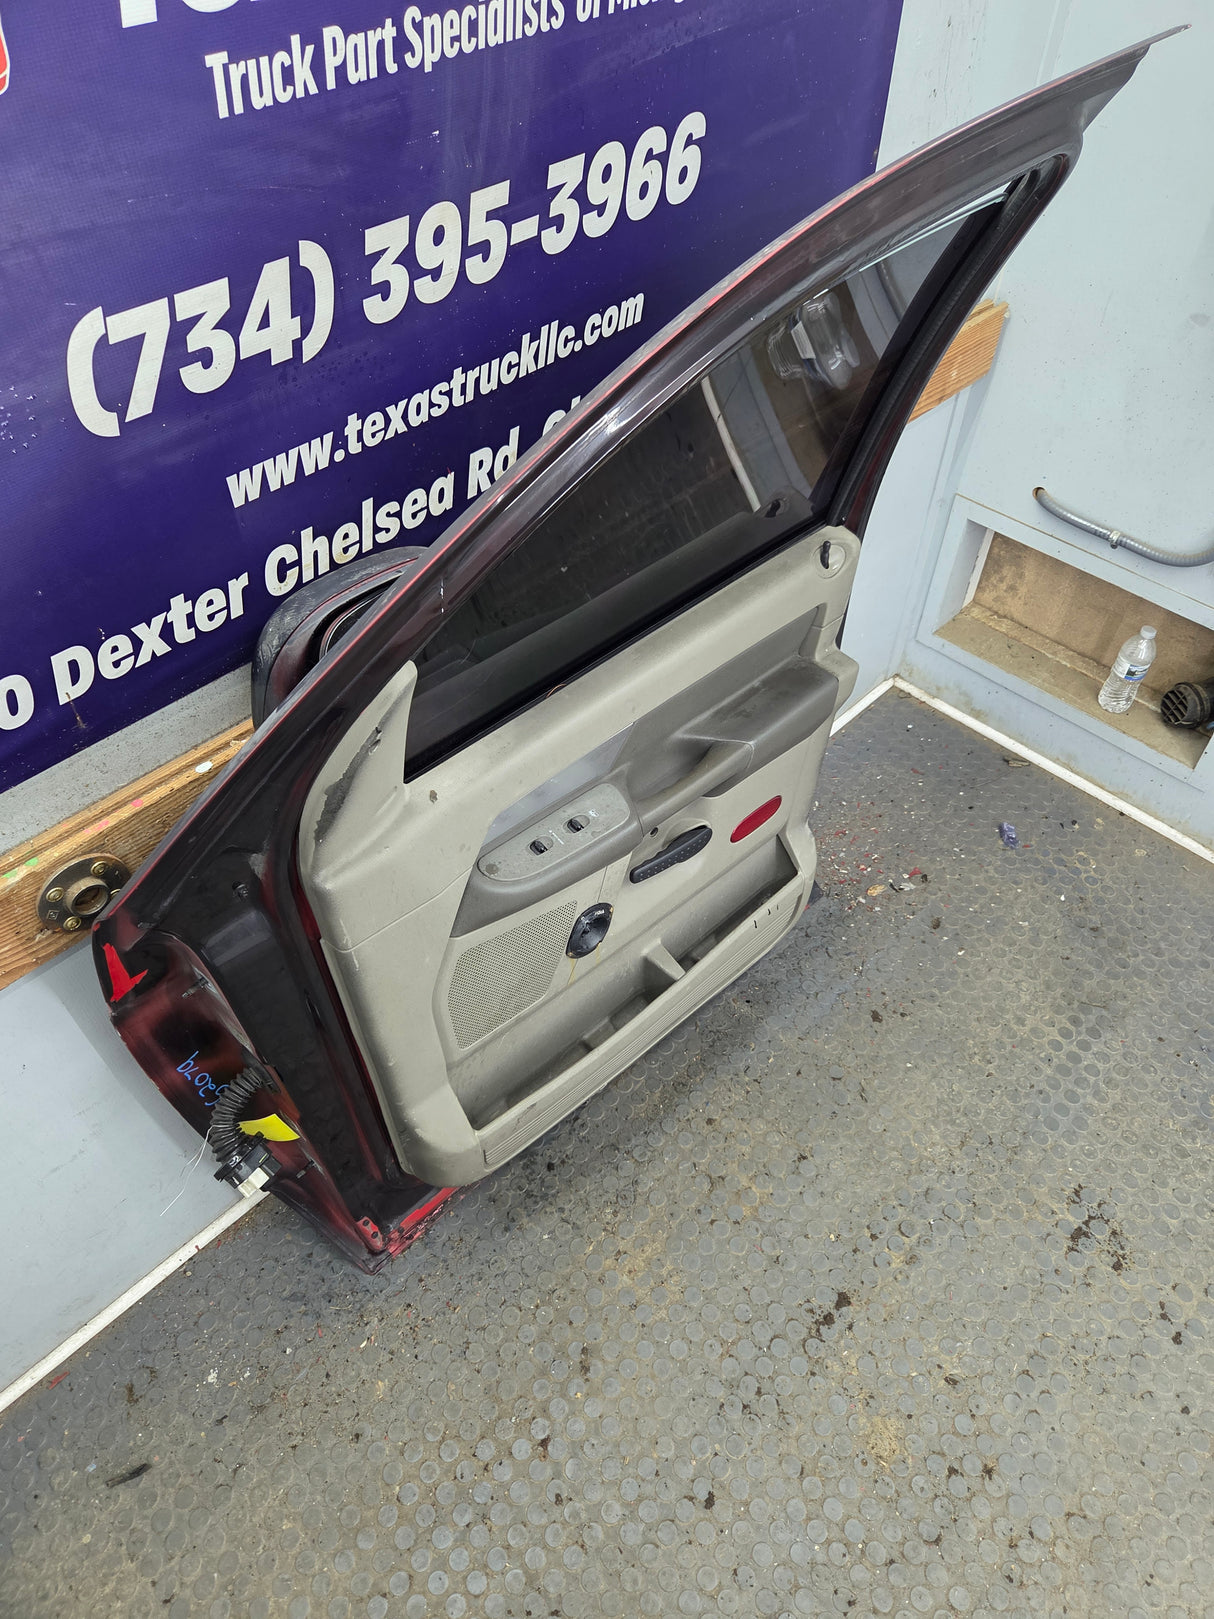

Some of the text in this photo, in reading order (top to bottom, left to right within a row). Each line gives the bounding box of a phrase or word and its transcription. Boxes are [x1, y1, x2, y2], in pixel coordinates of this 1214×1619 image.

[205, 33, 319, 120] Truck
[323, 18, 399, 91] Part
[404, 0, 565, 73] Specialists
[66, 111, 707, 438] (734) 395-3966
[226, 292, 645, 509] www.texastruckllc.com
[51, 571, 249, 706] Dexter
[264, 471, 455, 597] Chelsea
